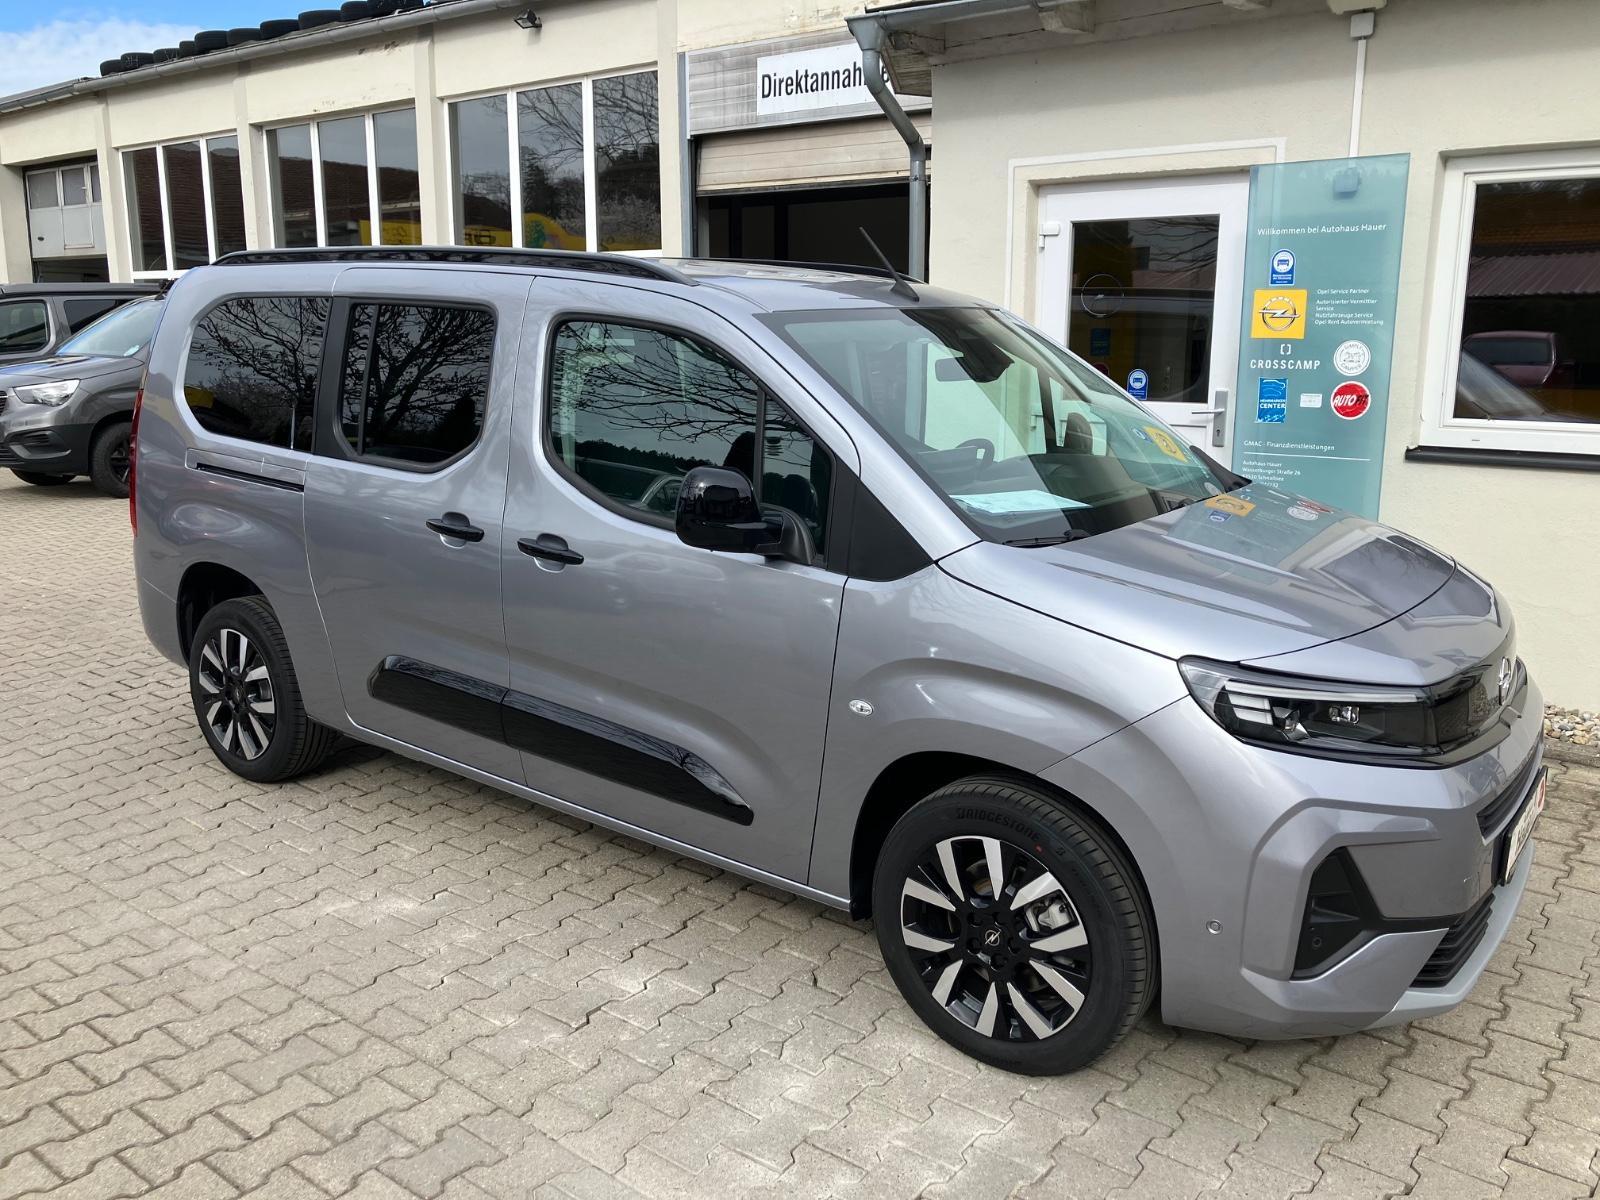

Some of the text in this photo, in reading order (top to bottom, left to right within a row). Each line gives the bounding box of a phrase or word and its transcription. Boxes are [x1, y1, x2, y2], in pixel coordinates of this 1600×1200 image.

[761, 61, 891, 99] Direktannahe
[1257, 223, 1387, 236] Willkommen bei Autohaus Hauer
[1250, 359, 1321, 370] CROSSCAMP
[955, 807, 1042, 842] BRIDGESTONE
